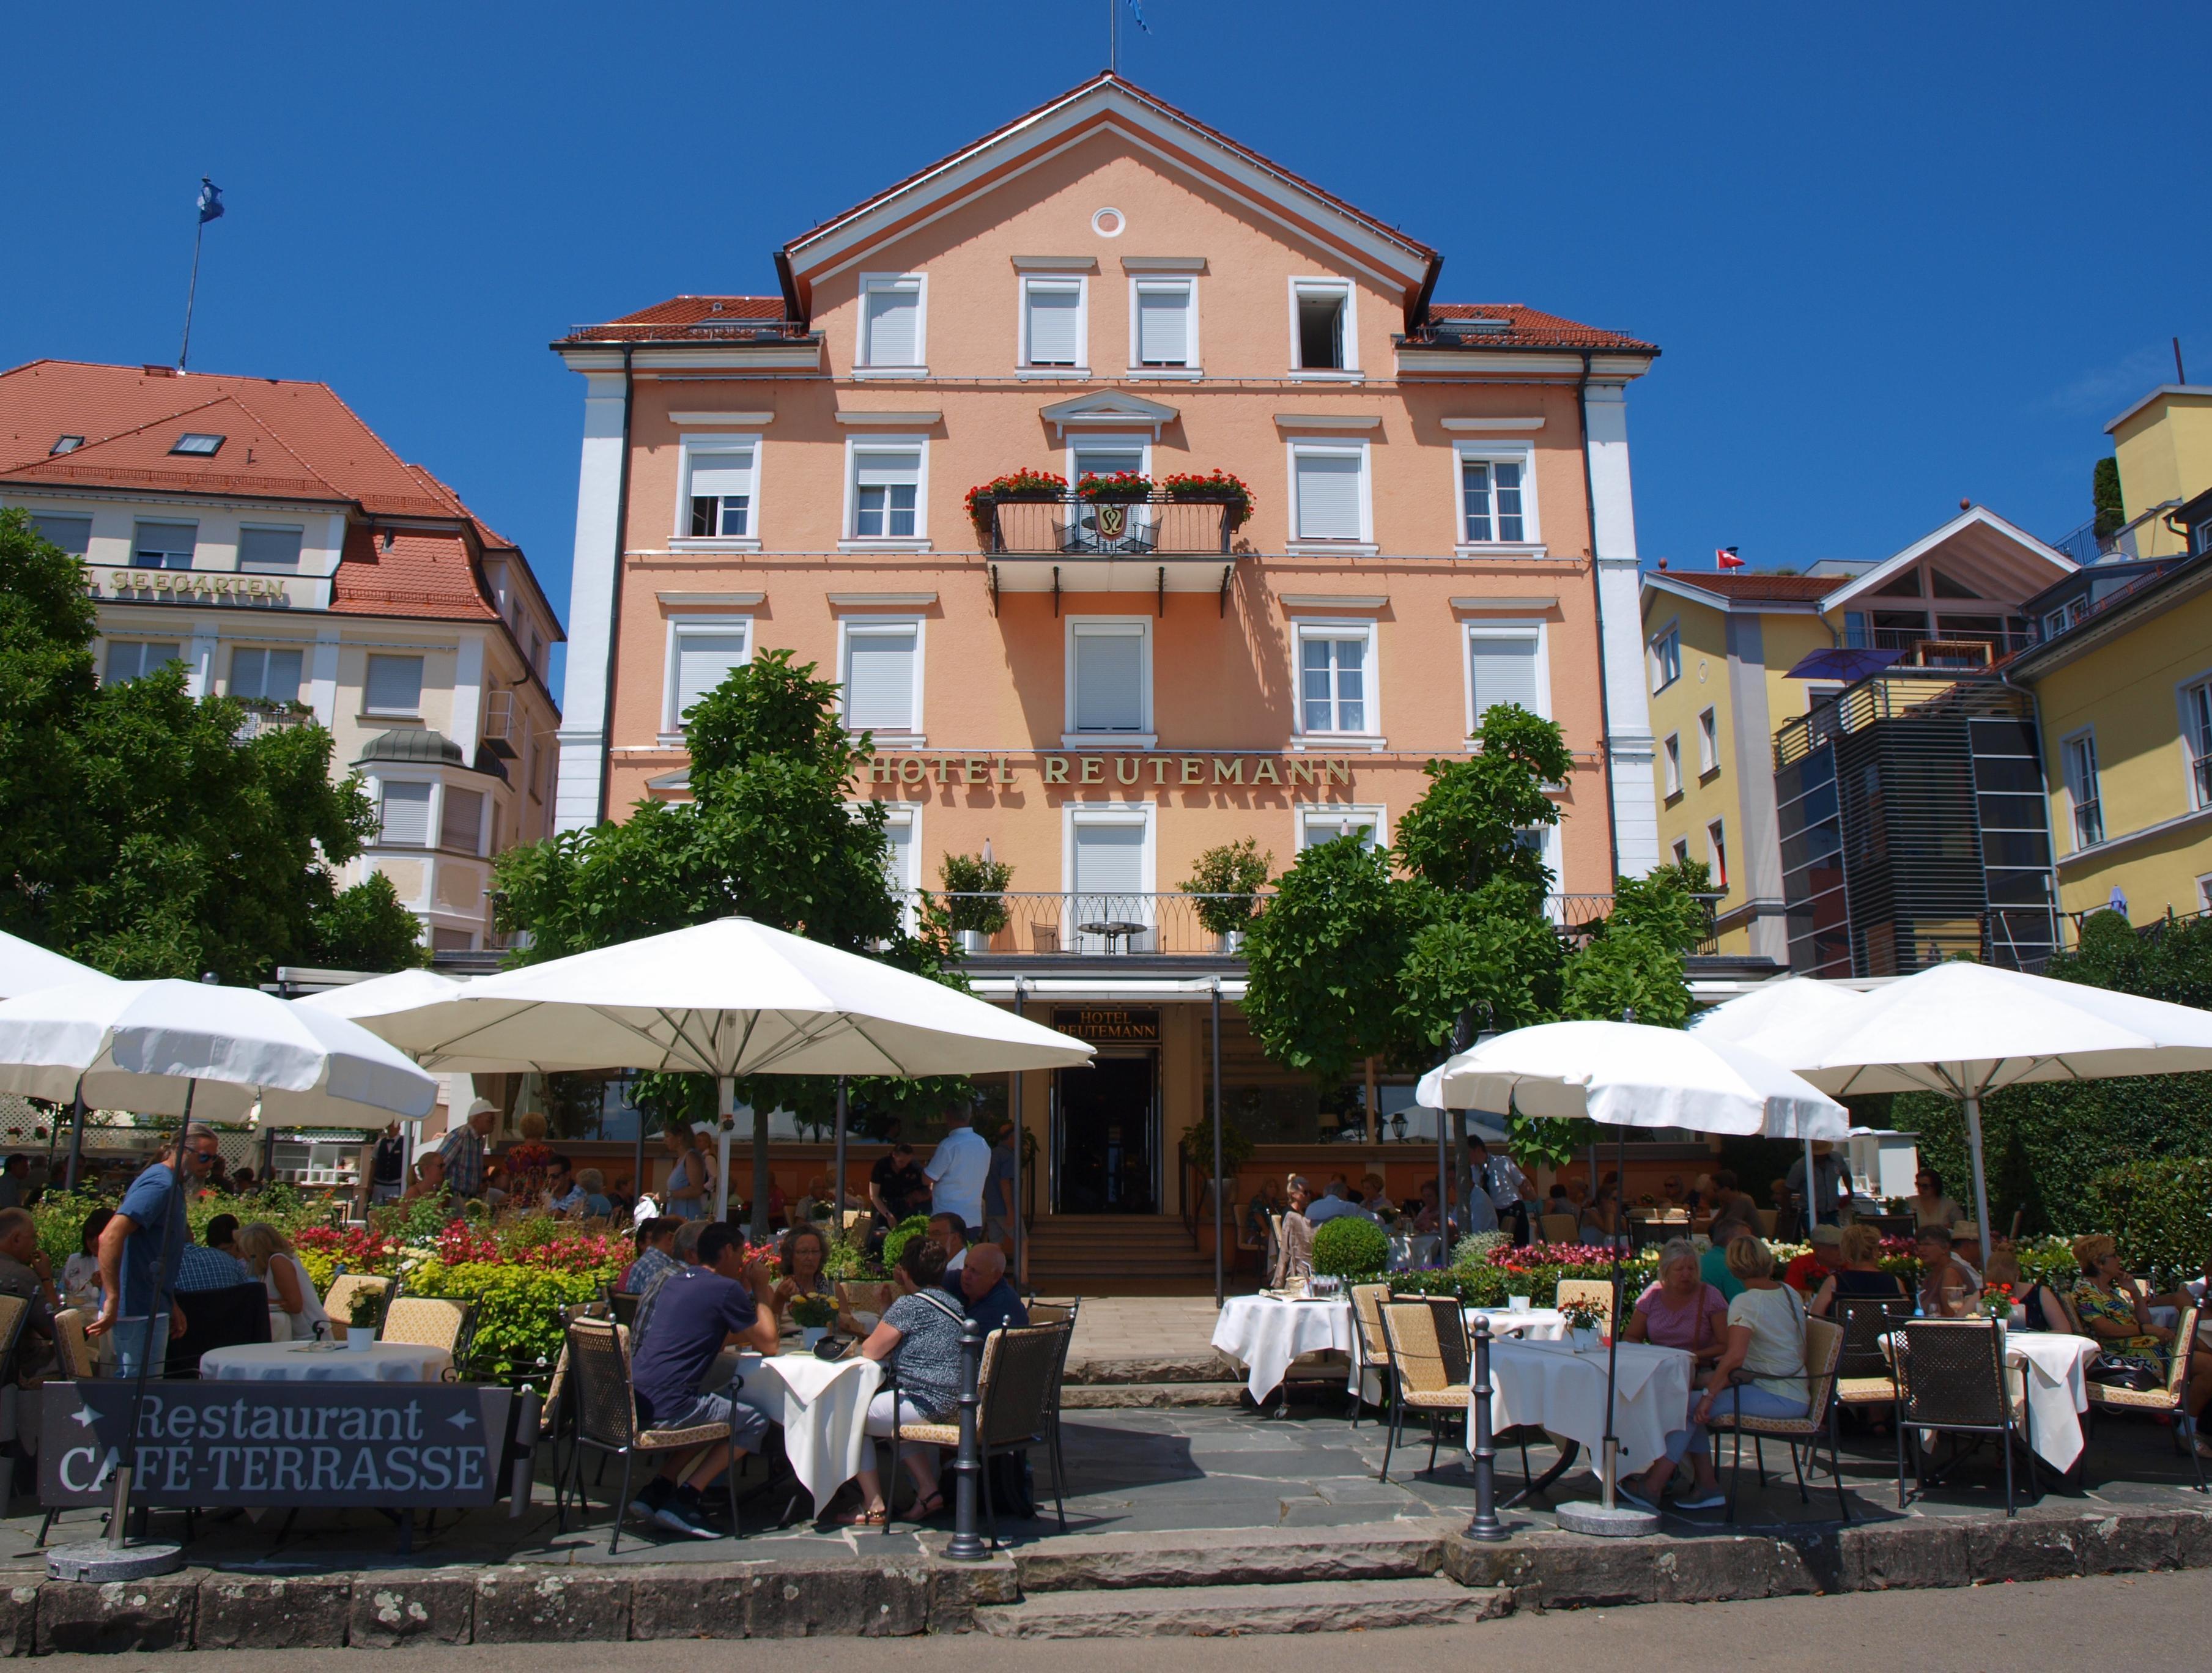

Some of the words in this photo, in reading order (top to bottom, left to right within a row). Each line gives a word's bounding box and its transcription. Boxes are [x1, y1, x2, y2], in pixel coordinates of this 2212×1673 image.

[110, 570, 285, 597] SEEGARTEN
[865, 758, 1020, 784] HOTEL
[1043, 756, 1350, 785] REUTEMANN
[1058, 1025, 1155, 1038] REUTEMANN
[1081, 1012, 1131, 1024] HOTEL
[128, 1395, 423, 1439] Restaurant
[59, 1439, 486, 1492] CAFÉ-TERRASSE
